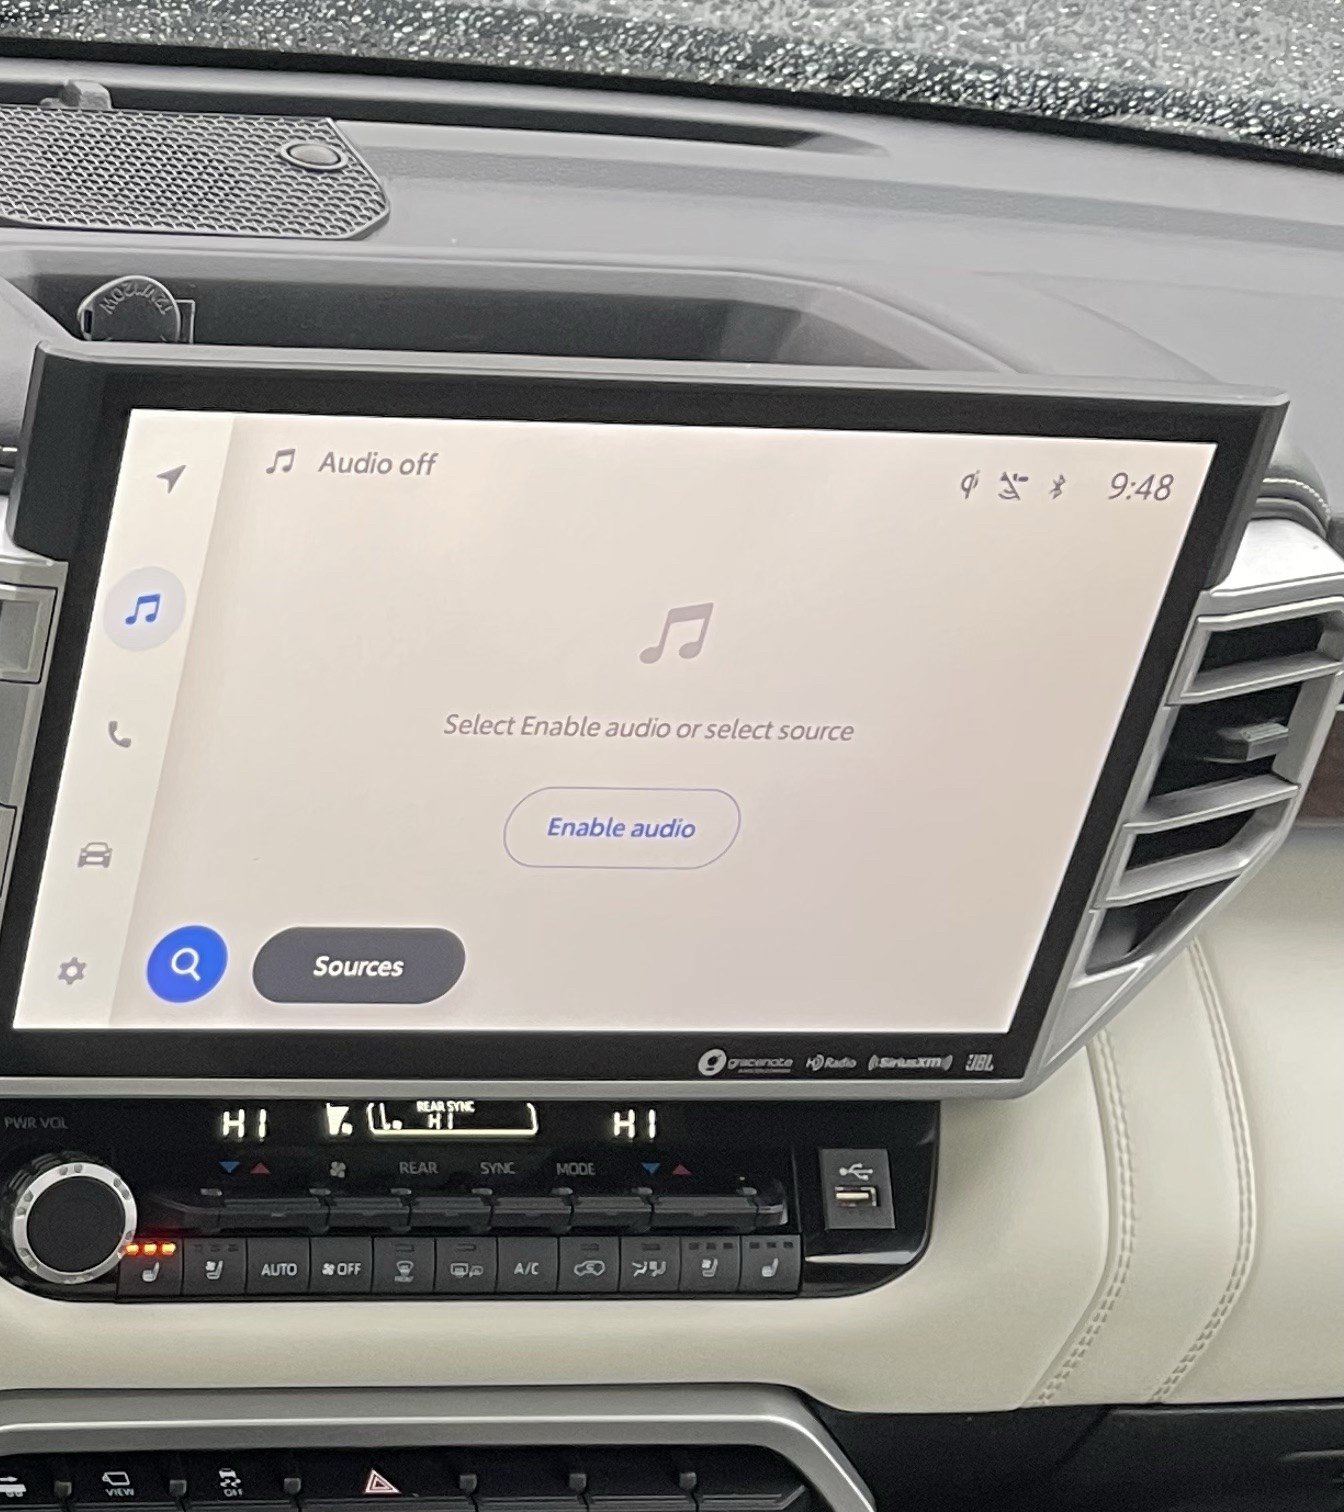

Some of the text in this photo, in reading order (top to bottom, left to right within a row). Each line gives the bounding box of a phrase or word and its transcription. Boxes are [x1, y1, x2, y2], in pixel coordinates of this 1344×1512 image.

[318, 451, 439, 477] Audio off
[1108, 472, 1174, 501] 9:48
[443, 714, 855, 742] Select Enable audio or select source
[546, 817, 697, 840] Enable audio
[312, 956, 404, 978] Sources
[965, 1054, 994, 1072] JBL
[416, 1100, 475, 1113] REAR SYNC
[4, 1116, 69, 1130] PWR VOL
[398, 1161, 439, 1175] REAR
[480, 1161, 516, 1175] SYNC
[556, 1162, 596, 1176] MODE
[261, 1263, 298, 1277] AUTO
[337, 1263, 362, 1276] OFF
[513, 1262, 540, 1276] A/C
